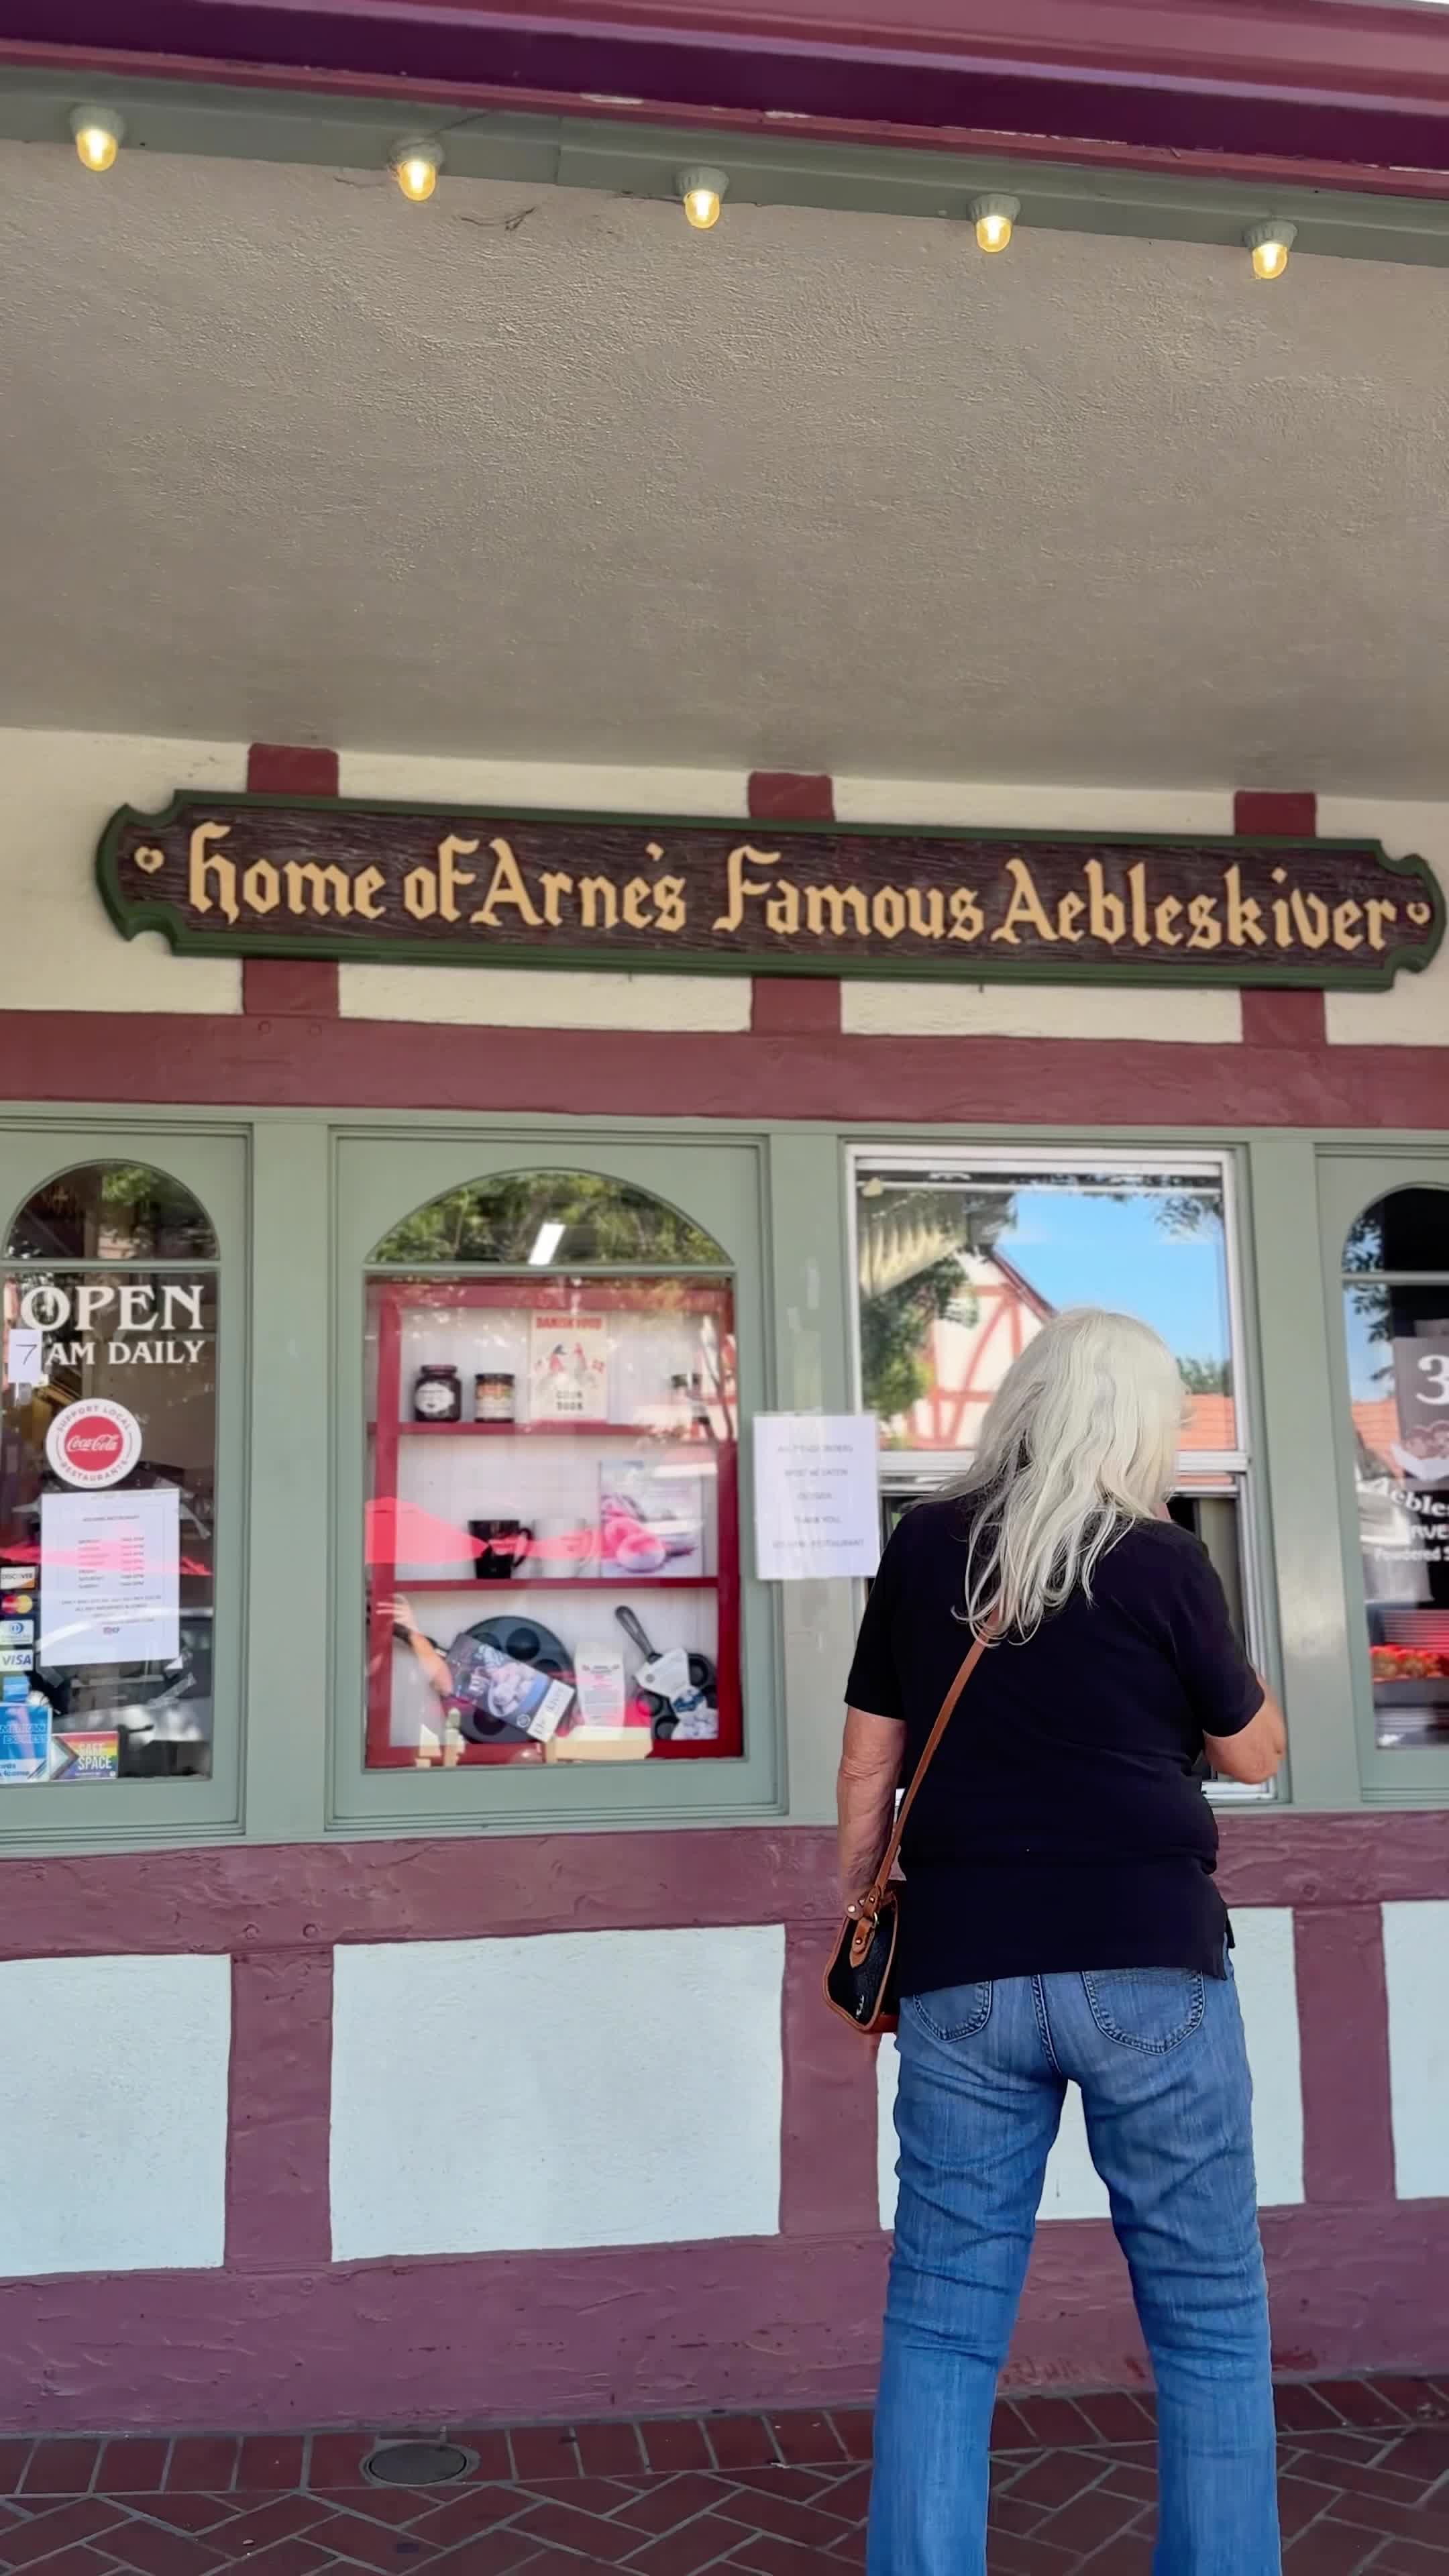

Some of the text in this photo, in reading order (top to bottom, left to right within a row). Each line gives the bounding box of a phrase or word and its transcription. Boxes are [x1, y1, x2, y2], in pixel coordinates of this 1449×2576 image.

[470, 835, 687, 933] Arne's
[711, 843, 985, 942] Famous
[990, 857, 1398, 952] Aebleskiver
[20, 1285, 205, 1332] OPEN
[15, 1343, 38, 1366] 7
[45, 1340, 205, 1366] AM DAILY
[3, 1654, 32, 1665] VISA
[77, 1754, 113, 1770] SPACE
